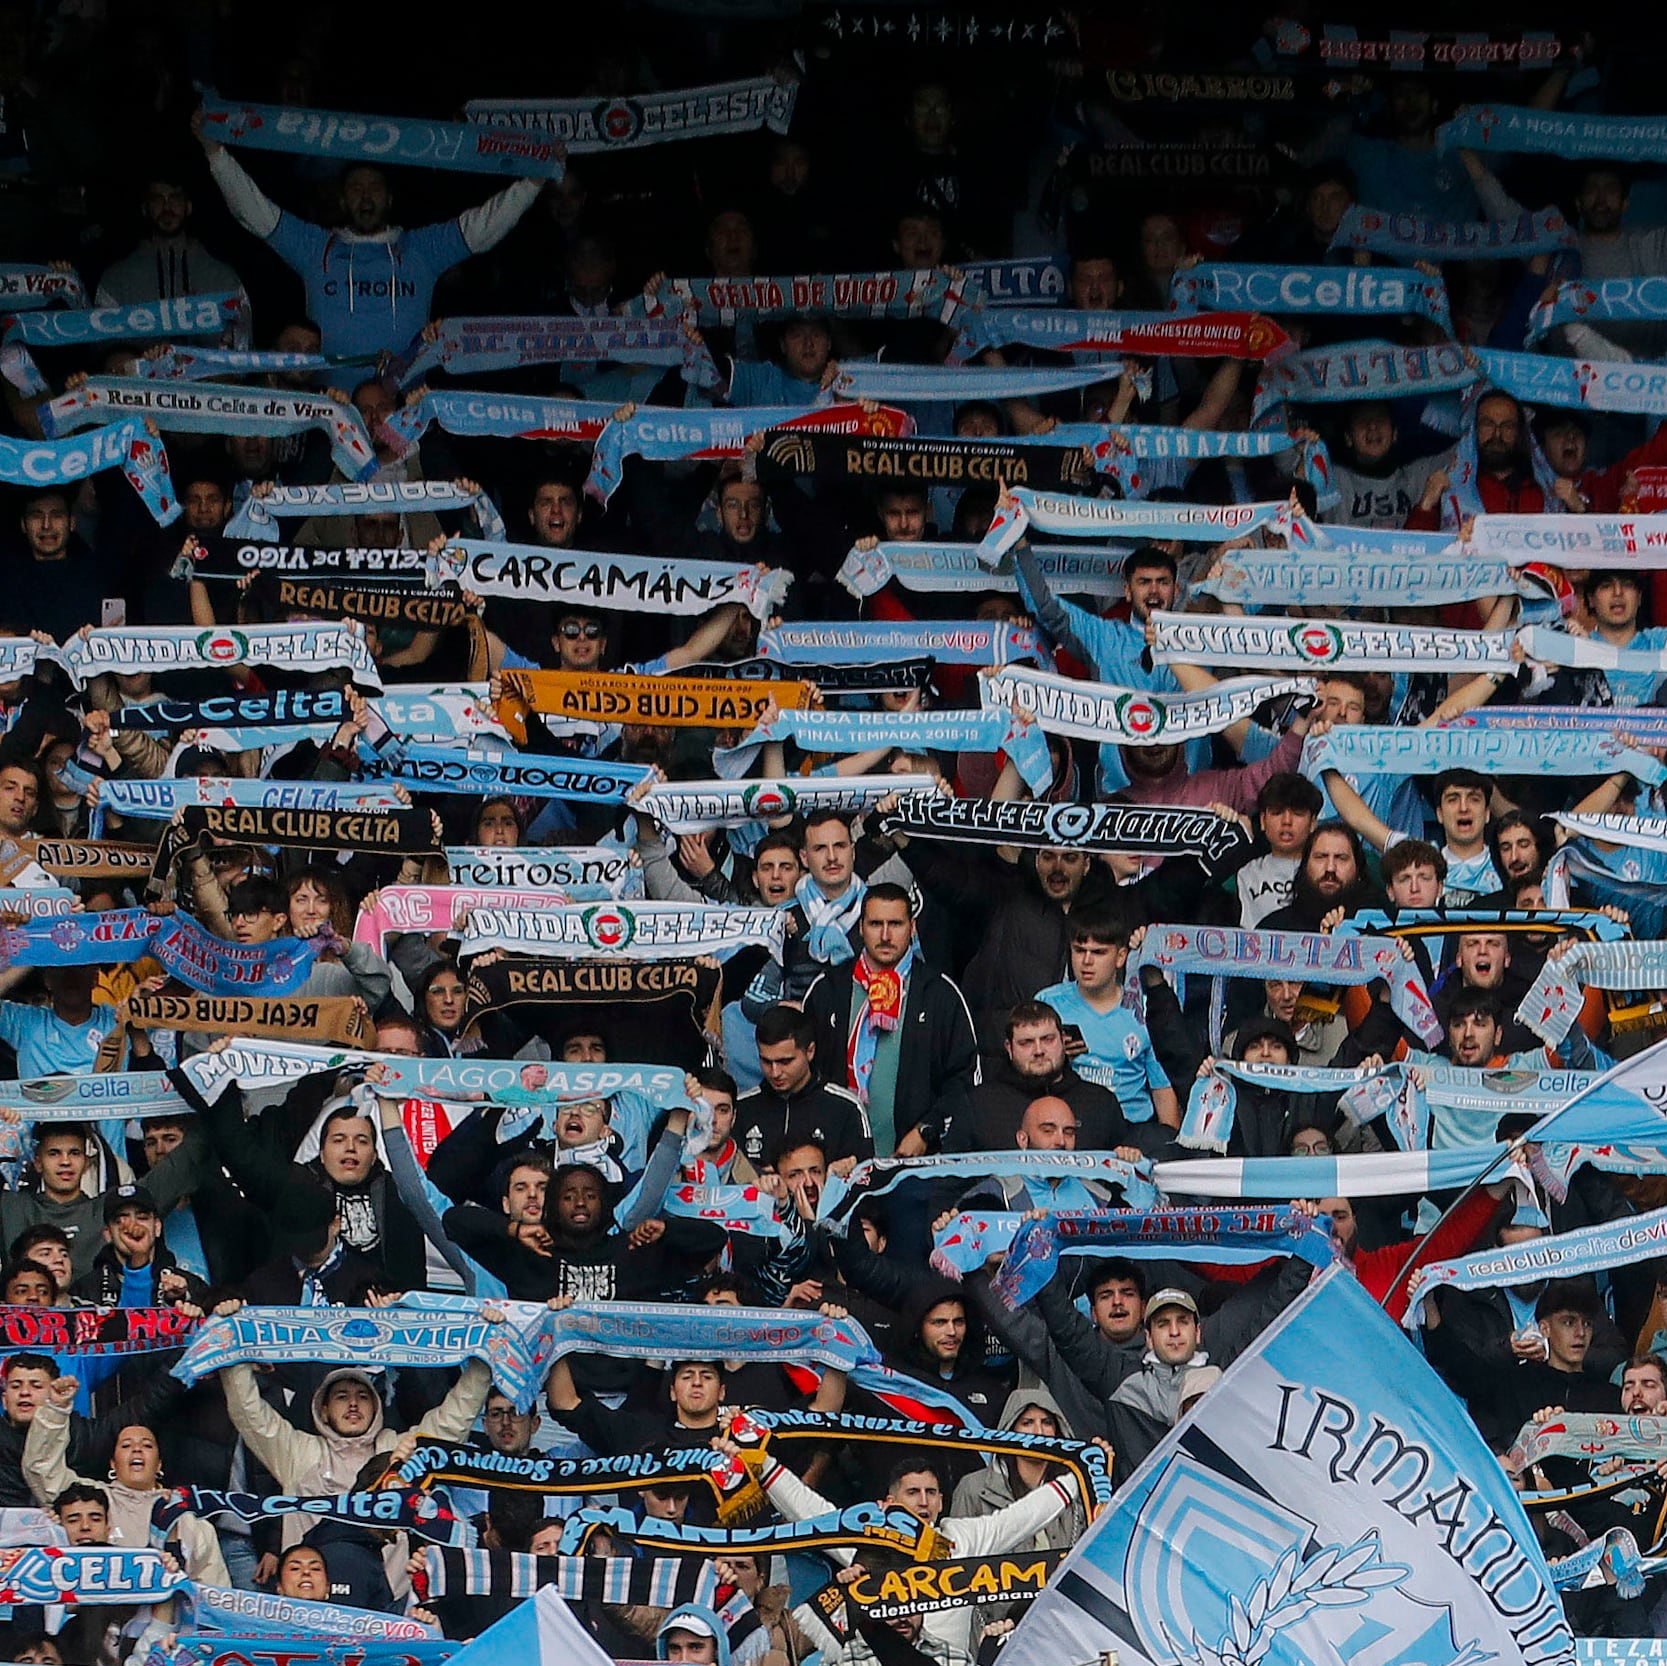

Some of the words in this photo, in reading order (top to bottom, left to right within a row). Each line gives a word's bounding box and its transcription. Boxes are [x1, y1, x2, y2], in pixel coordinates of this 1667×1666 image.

[1526, 118, 1576, 133] NOSA
[708, 282, 782, 308] CELTA
[794, 281, 825, 307] DE
[834, 279, 896, 304] VIGO
[1131, 323, 1198, 340] MANCHESTER
[1202, 325, 1241, 341] UNITED
[108, 391, 151, 408] Real
[156, 394, 201, 412] Club
[207, 396, 260, 414] Celta
[264, 400, 286, 417] de
[847, 451, 903, 477] REAL
[907, 453, 965, 479] CLUB
[969, 457, 1028, 482] CELTA
[279, 583, 337, 614] REAL
[342, 587, 401, 618] CLUB
[404, 595, 467, 628] CELTA
[1157, 624, 1289, 657] MOVIDA
[1341, 628, 1512, 662] CELESTE
[988, 674, 1117, 728] MOVIDA
[794, 711, 864, 726] NOSA
[868, 709, 1002, 725] RECONQUISTA
[798, 729, 836, 742] FINAL
[840, 730, 920, 743] TEMPADA
[924, 727, 980, 742] 2018-19
[206, 807, 266, 837] REAL
[270, 808, 329, 838] CLUB
[335, 812, 400, 843] CELTA
[1195, 927, 1366, 971] CELTA
[508, 969, 566, 995] REAL
[571, 968, 633, 993] CLUB
[637, 963, 698, 990] CELTA
[417, 1062, 516, 1090] IAGO
[547, 1066, 673, 1095] ASPAS
[236, 1319, 320, 1348] CELTA
[404, 1320, 487, 1348] VIGO
[450, 1448, 556, 1480] Sempre
[579, 1454, 654, 1476] Noxe
[331, 1582, 351, 1596] HH
